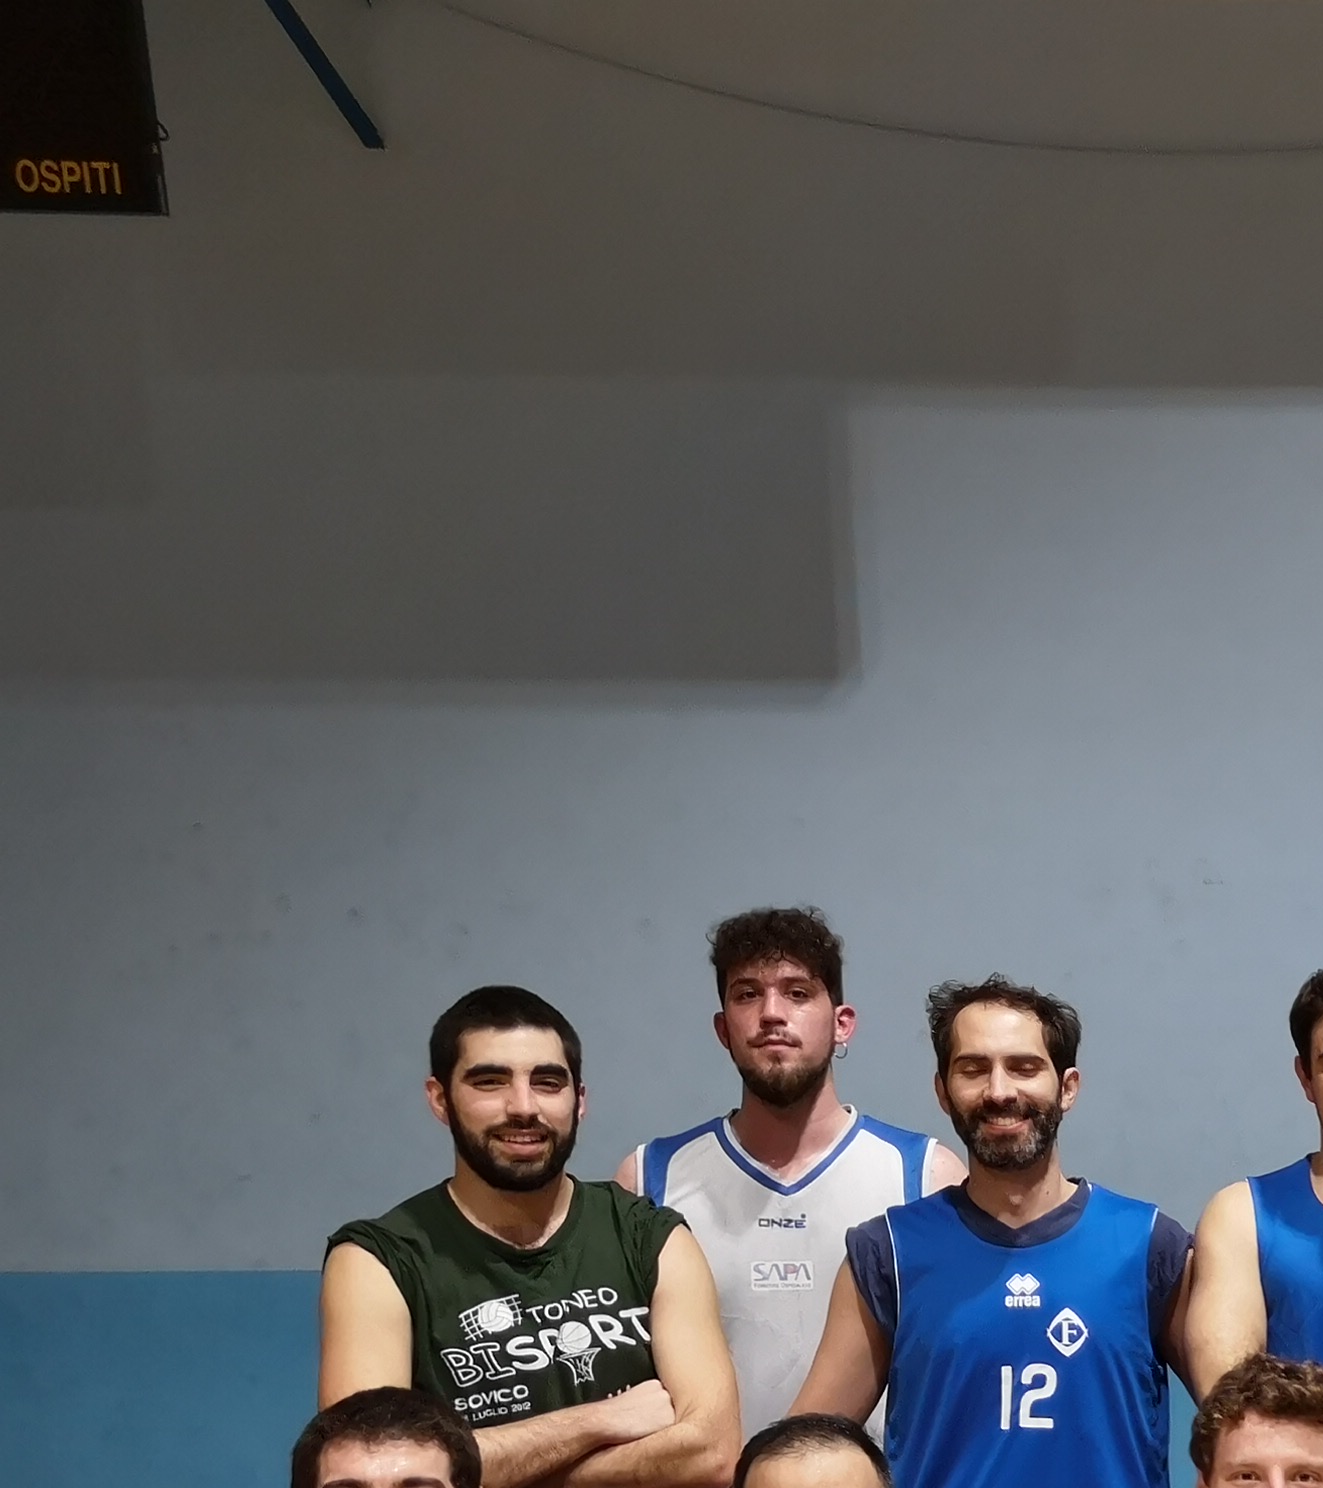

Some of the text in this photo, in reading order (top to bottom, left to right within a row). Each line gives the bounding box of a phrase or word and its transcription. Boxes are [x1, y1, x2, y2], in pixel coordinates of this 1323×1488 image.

[15, 159, 122, 194] OSPITI
[753, 1263, 811, 1281] SAPA
[1005, 1293, 1041, 1308] errea
[454, 1385, 529, 1411] SOVICO
[1000, 1363, 1058, 1431] 12
